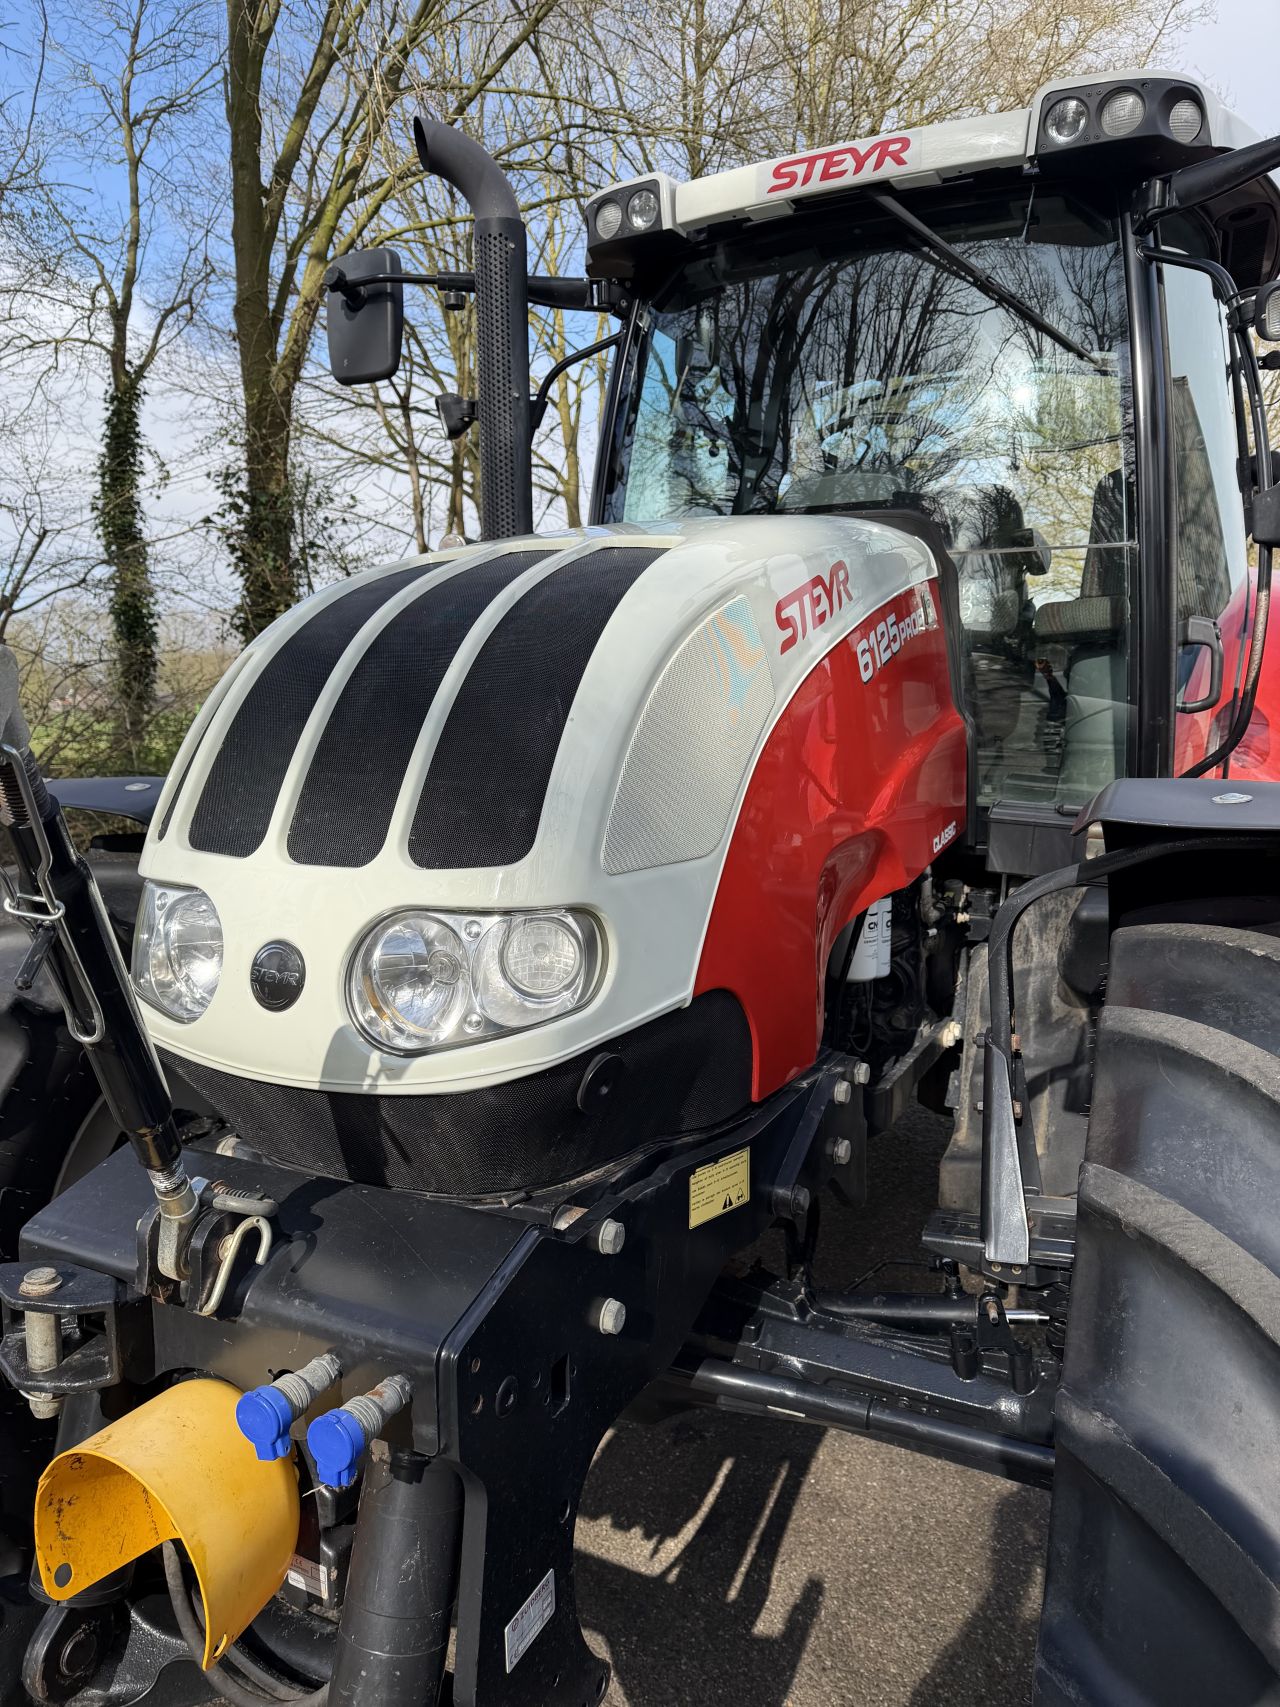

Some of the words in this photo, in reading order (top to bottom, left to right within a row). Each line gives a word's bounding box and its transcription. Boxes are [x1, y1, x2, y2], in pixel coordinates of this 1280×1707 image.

[767, 137, 911, 193] STEYR
[775, 560, 853, 656] STEYR
[933, 820, 956, 854] CLASSIC
[868, 921, 878, 930] CN
[251, 966, 299, 986] STEYR
